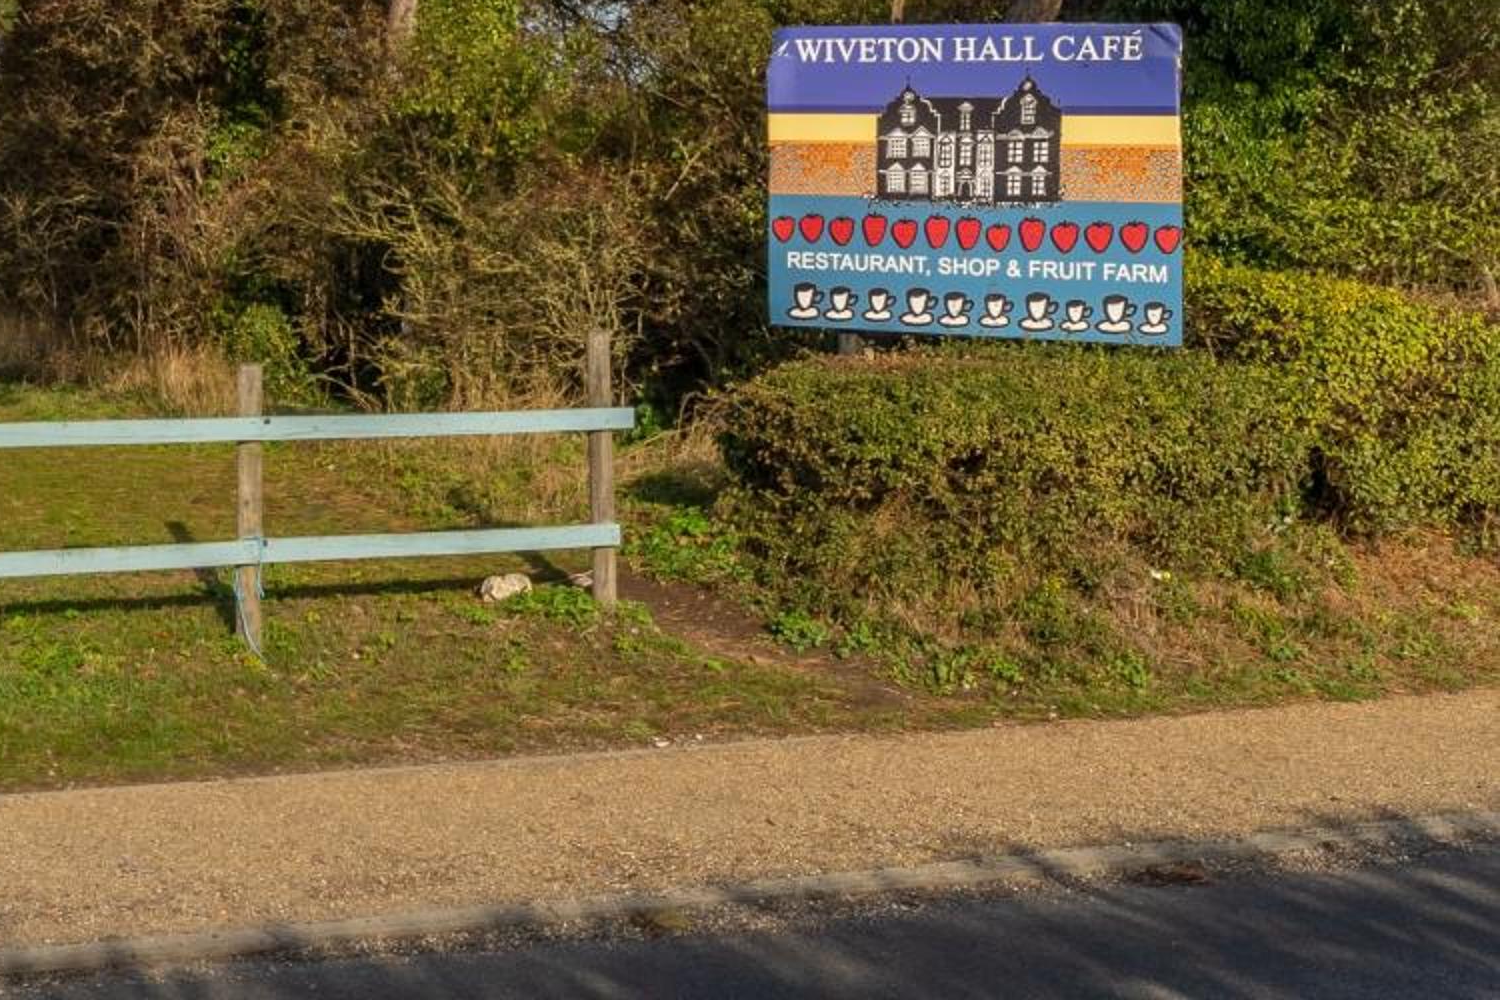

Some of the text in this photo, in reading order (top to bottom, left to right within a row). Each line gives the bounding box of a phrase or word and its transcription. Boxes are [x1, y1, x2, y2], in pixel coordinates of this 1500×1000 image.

[795, 29, 1143, 63] WIVETON HALL CAFÉ
[787, 252, 1168, 284] RESTAURANT, SHOP & FRUIT FARM
